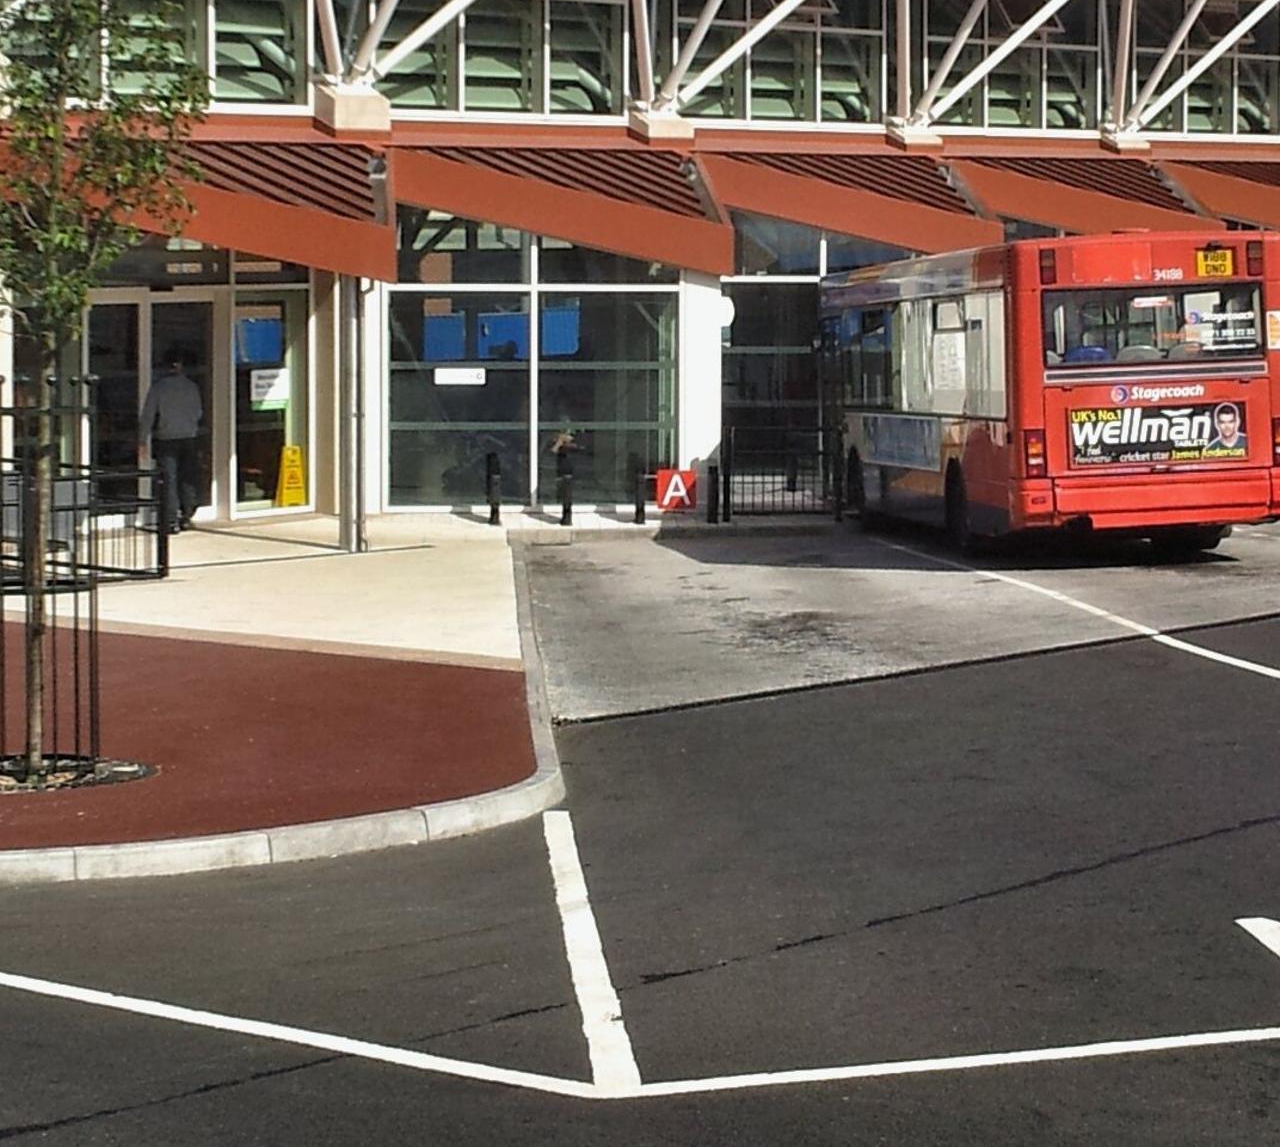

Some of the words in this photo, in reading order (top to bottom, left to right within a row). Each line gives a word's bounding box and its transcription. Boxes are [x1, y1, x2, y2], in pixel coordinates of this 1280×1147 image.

[1131, 384, 1205, 402] Stagecoach
[1071, 410, 1096, 422] UK's
[1072, 407, 1211, 446] wellman
[662, 473, 691, 506] A
